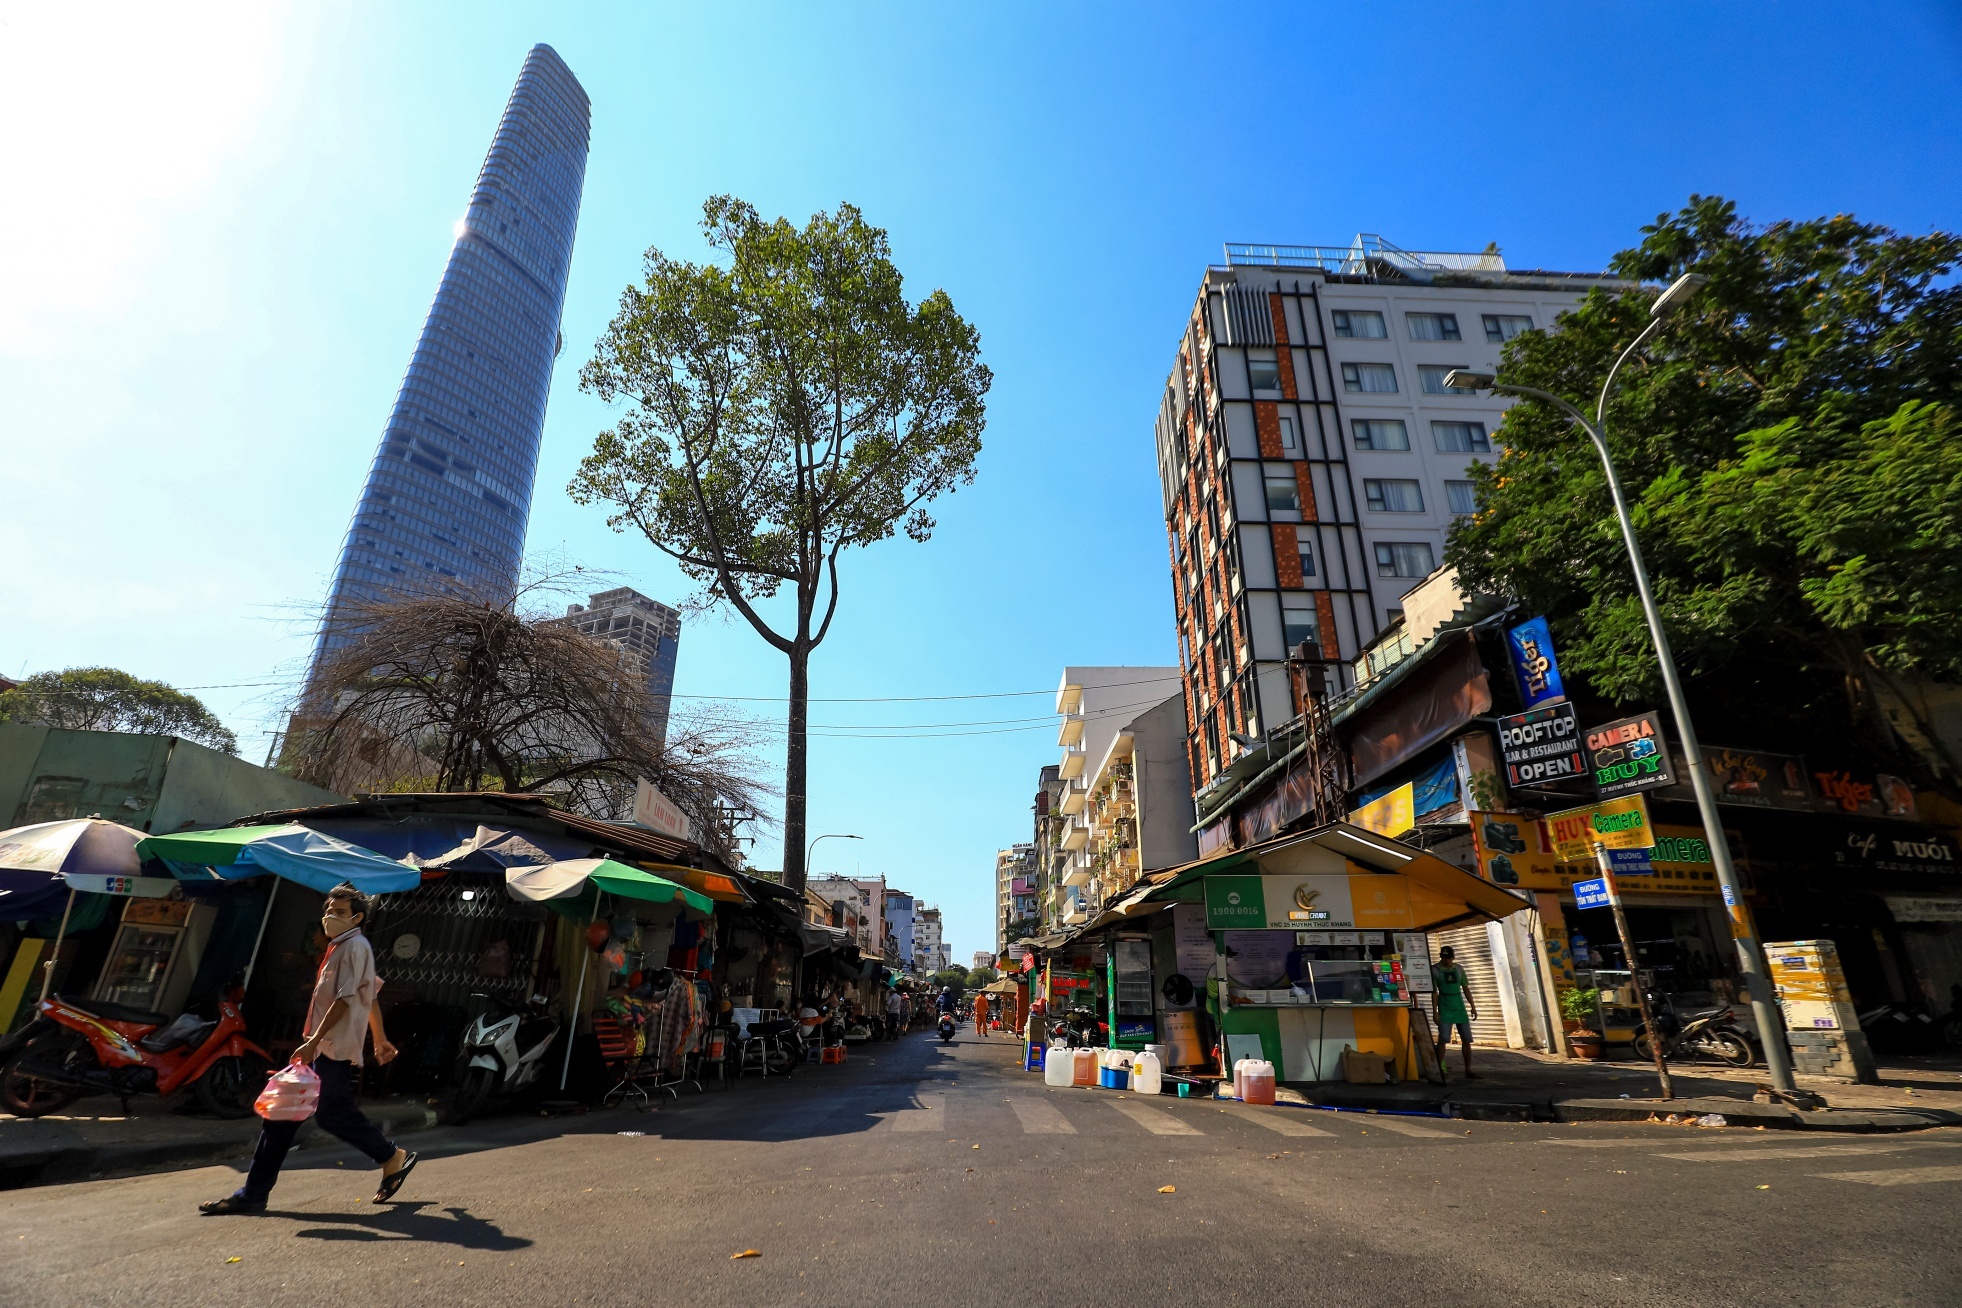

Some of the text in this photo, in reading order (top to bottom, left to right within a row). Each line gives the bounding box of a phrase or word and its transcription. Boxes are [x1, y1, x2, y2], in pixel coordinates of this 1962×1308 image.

[1521, 639, 1549, 697] Tiger
[1501, 716, 1575, 752] ROOFTOP
[1587, 720, 1655, 750] CAMERA
[1505, 739, 1578, 763] BAR & RESTAURANT
[1520, 757, 1571, 780] OPEN
[1595, 754, 1662, 785] HUY
[1814, 769, 1873, 812] Tiger
[1554, 810, 1643, 843] HUY Camera
[1559, 843, 1569, 851] 27
[1892, 837, 1954, 862] MUỐI
[106, 877, 133, 893] JCB
[1580, 884, 1600, 893] ĐƯỜNG
